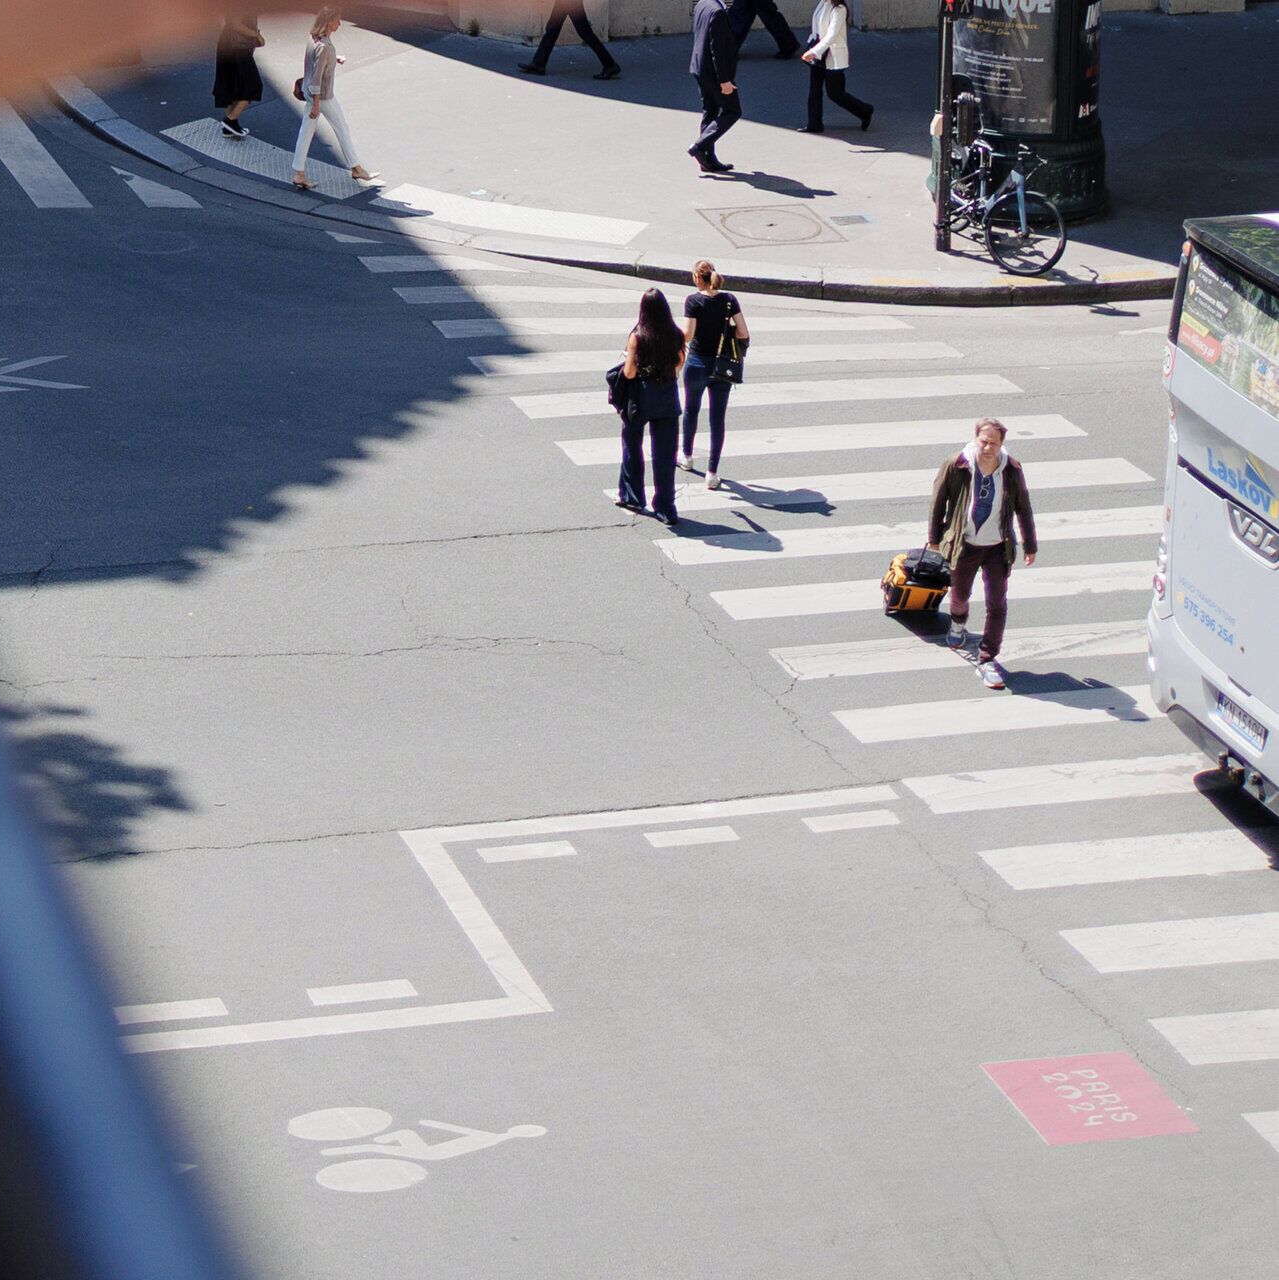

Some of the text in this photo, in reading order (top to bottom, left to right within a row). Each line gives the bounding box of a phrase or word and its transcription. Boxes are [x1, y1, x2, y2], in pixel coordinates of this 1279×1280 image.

[1233, 509, 1277, 556] VDL
[1184, 596, 1233, 646] 575 396 254
[1042, 1072, 1104, 1126] 2024
